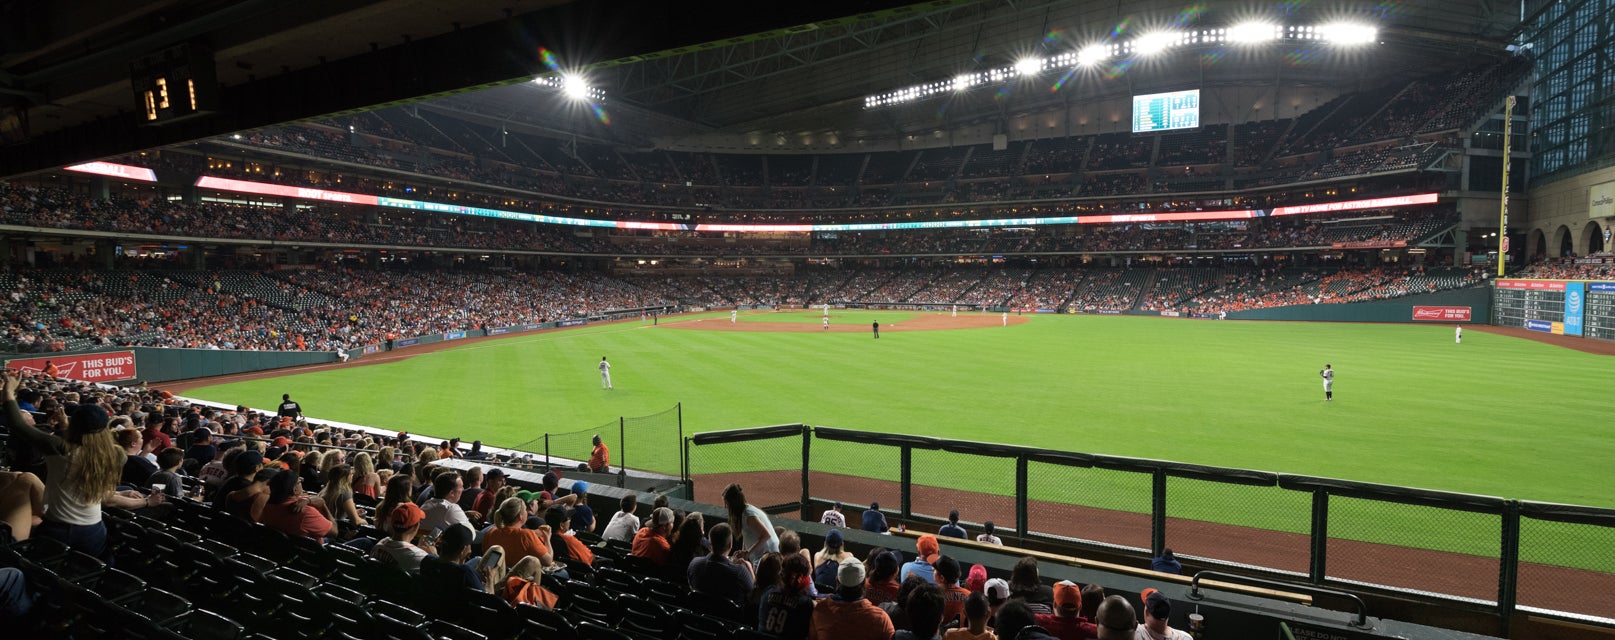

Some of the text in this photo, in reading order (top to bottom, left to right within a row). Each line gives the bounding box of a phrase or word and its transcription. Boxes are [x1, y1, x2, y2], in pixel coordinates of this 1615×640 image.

[82, 356, 133, 369] THIS BUD'S
[82, 366, 124, 378] FOR YOU.
[766, 606, 789, 633] 69
